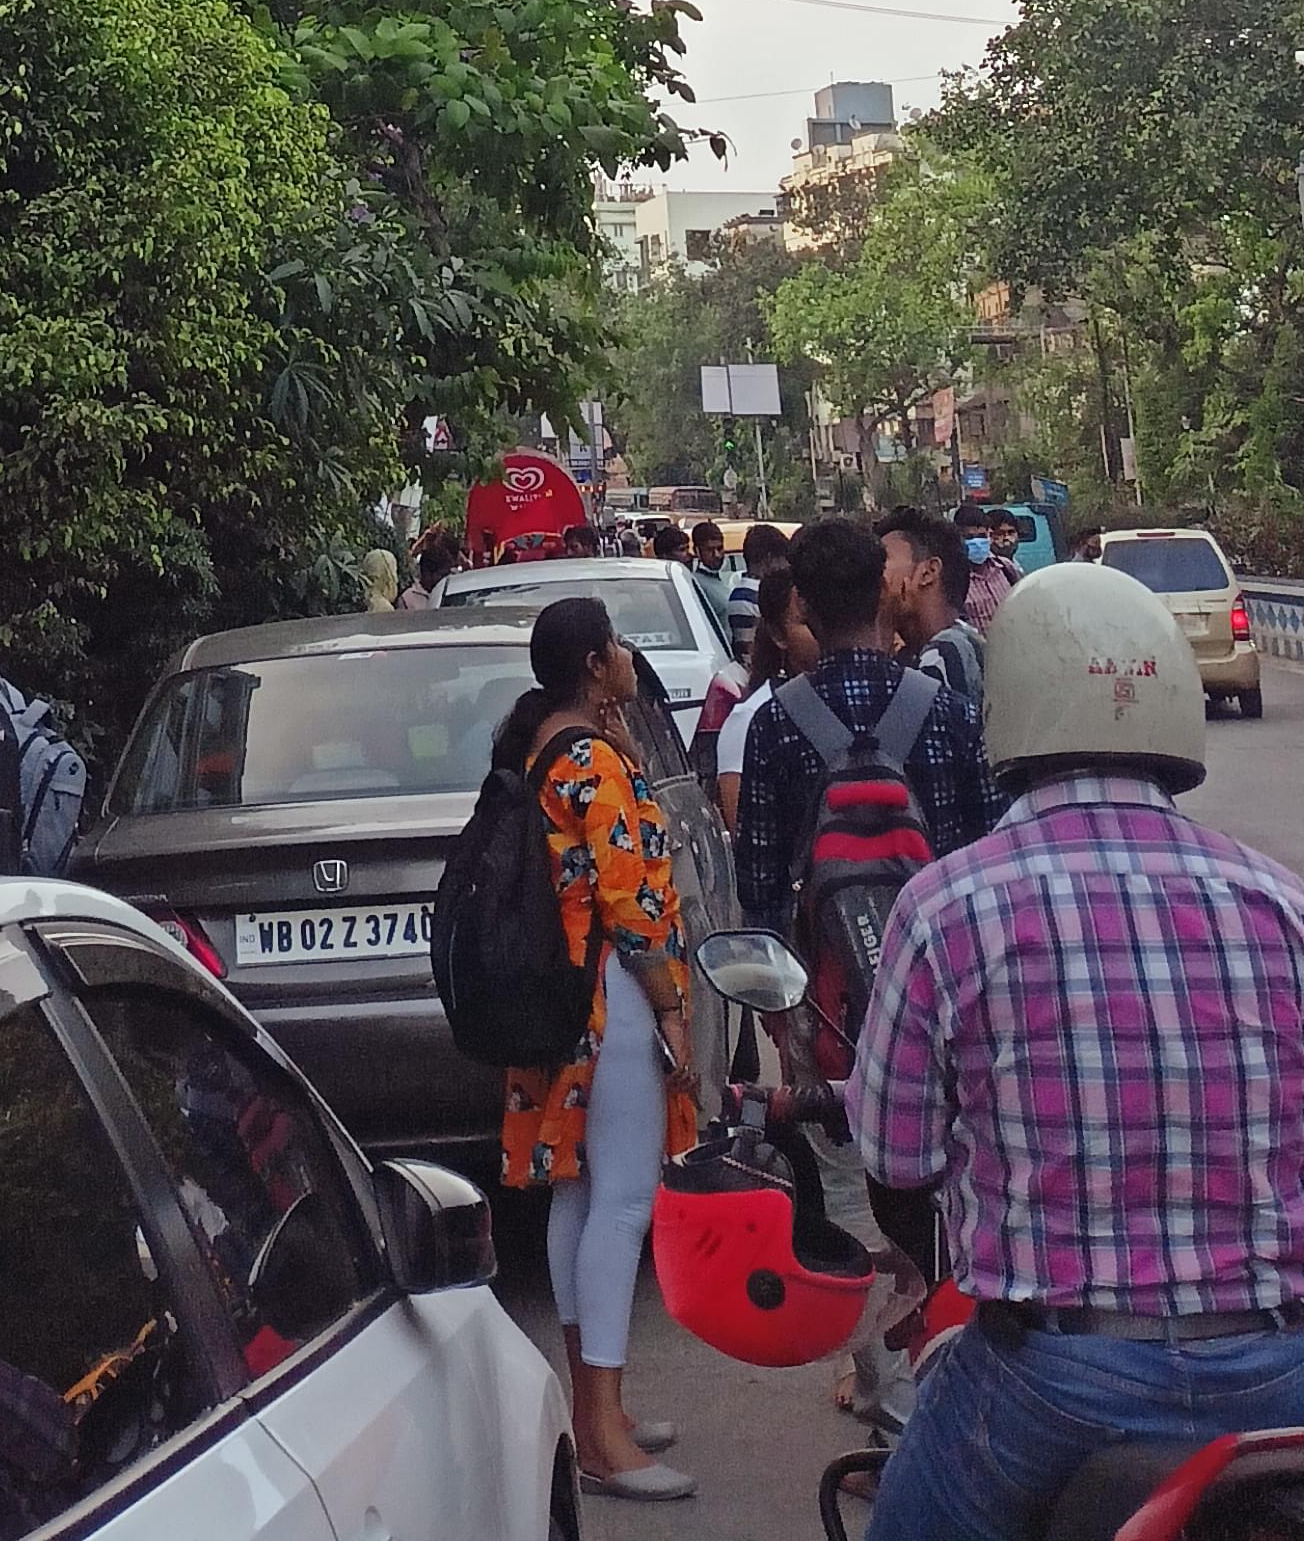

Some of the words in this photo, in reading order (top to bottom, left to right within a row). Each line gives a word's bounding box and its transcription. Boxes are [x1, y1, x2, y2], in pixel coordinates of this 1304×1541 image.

[259, 920, 293, 953] WB
[300, 918, 334, 951] 02
[342, 916, 358, 948] Z
